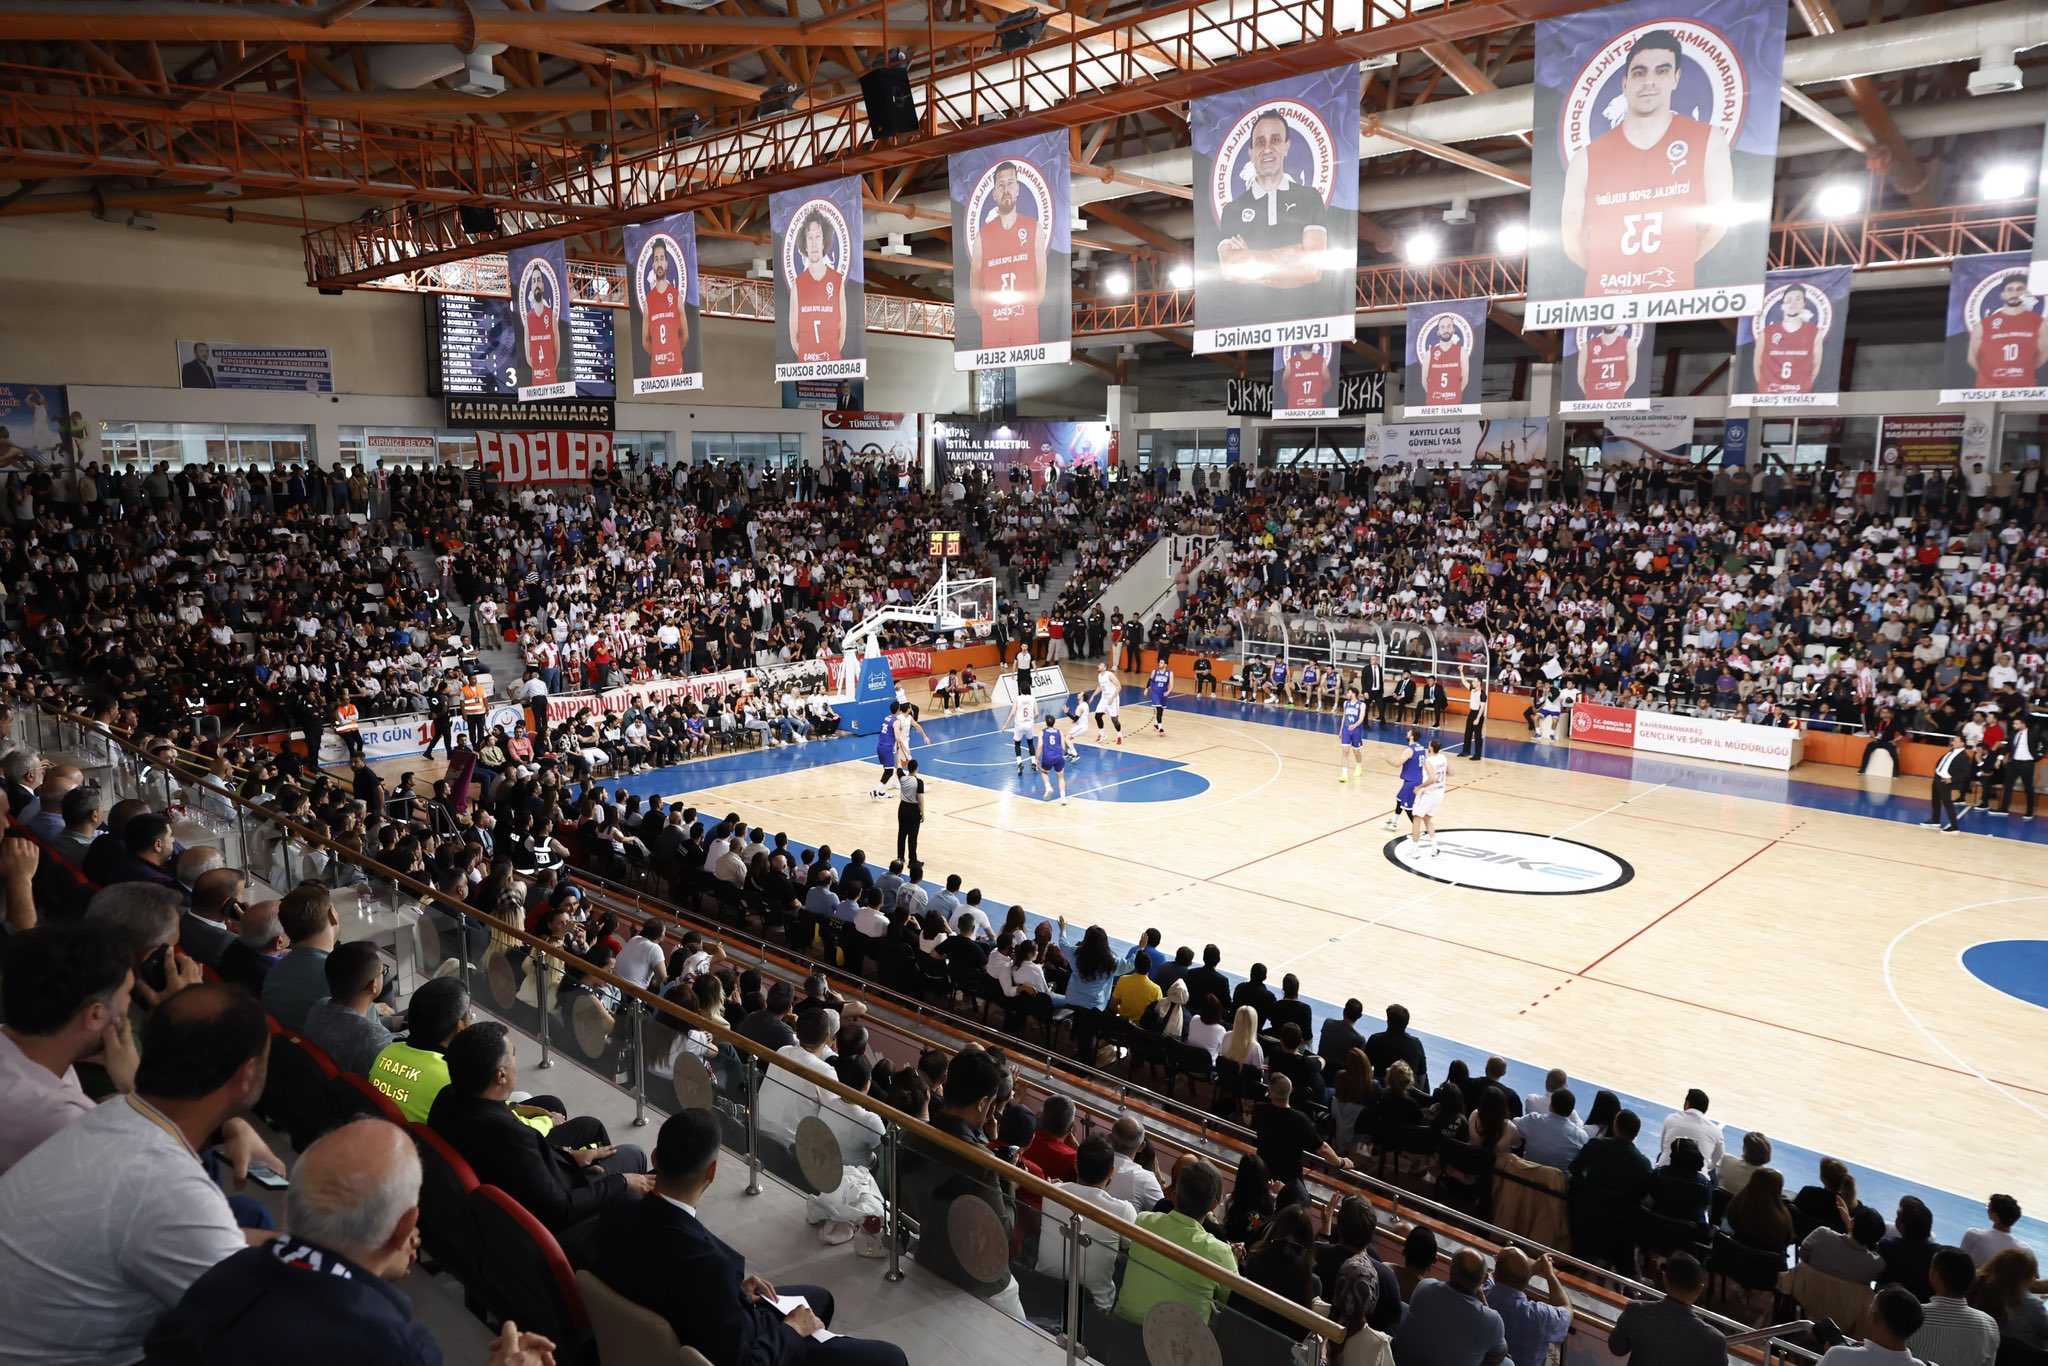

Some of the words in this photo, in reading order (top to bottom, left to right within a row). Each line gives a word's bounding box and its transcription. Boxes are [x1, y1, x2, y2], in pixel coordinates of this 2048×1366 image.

[2002, 343, 2019, 361] 10
[1601, 364, 1615, 379] 21
[1781, 361, 1792, 379] 6
[505, 367, 518, 387] 3
[1441, 373, 1448, 388] 5
[1227, 378, 1273, 413] ÇIKMA
[1338, 373, 1386, 411] OKAK
[1302, 381, 1312, 395] 17
[1752, 396, 1779, 405] BARIŞ
[1783, 394, 1816, 403] YENİAY
[1961, 390, 1997, 400] YUSUF
[2001, 389, 2046, 398] BAYRAK
[1441, 406, 1463, 414] İLHAN
[1573, 403, 1603, 411] SERKAN
[1606, 401, 1632, 409] ÖZVER
[450, 402, 610, 426] KAHRAMANMARAŞ
[1307, 409, 1326, 418] ÇAKIR
[849, 420, 881, 428] TÜRKİYE
[945, 426, 971, 439] KİPAŞ
[1409, 428, 1438, 437] KAYITLI
[1439, 427, 1461, 437] ÇALIŞ
[370, 438, 402, 446] KIRMIZI
[404, 439, 432, 447] BEYAZ
[945, 438, 983, 450] İSTİKLAL
[983, 440, 1031, 450] BASKETBOL
[1408, 438, 1440, 447] GÜVENLİ
[1441, 437, 1462, 447] YAŞA
[945, 452, 995, 461] TAKIMIMIZA
[930, 542, 942, 556] 20
[947, 542, 959, 556] 20
[867, 680, 887, 689] BRIDGE
[1030, 674, 1053, 689] LGAH
[1023, 707, 1029, 717] 6
[1639, 720, 1704, 736] KAHRAMANMARAŞ
[362, 731, 382, 745] ER
[383, 726, 412, 742] GÜN
[1049, 735, 1056, 745] 6
[1639, 729, 1675, 744] GENÇLİK
[1676, 735, 1687, 743] VE
[1689, 736, 1713, 747] SPOR
[1714, 735, 1722, 748] İL
[1724, 738, 1789, 757] MÜDÜRLÜĞÜ
[1435, 771, 1445, 783] 21
[378, 1056, 422, 1082] TRAFİK
